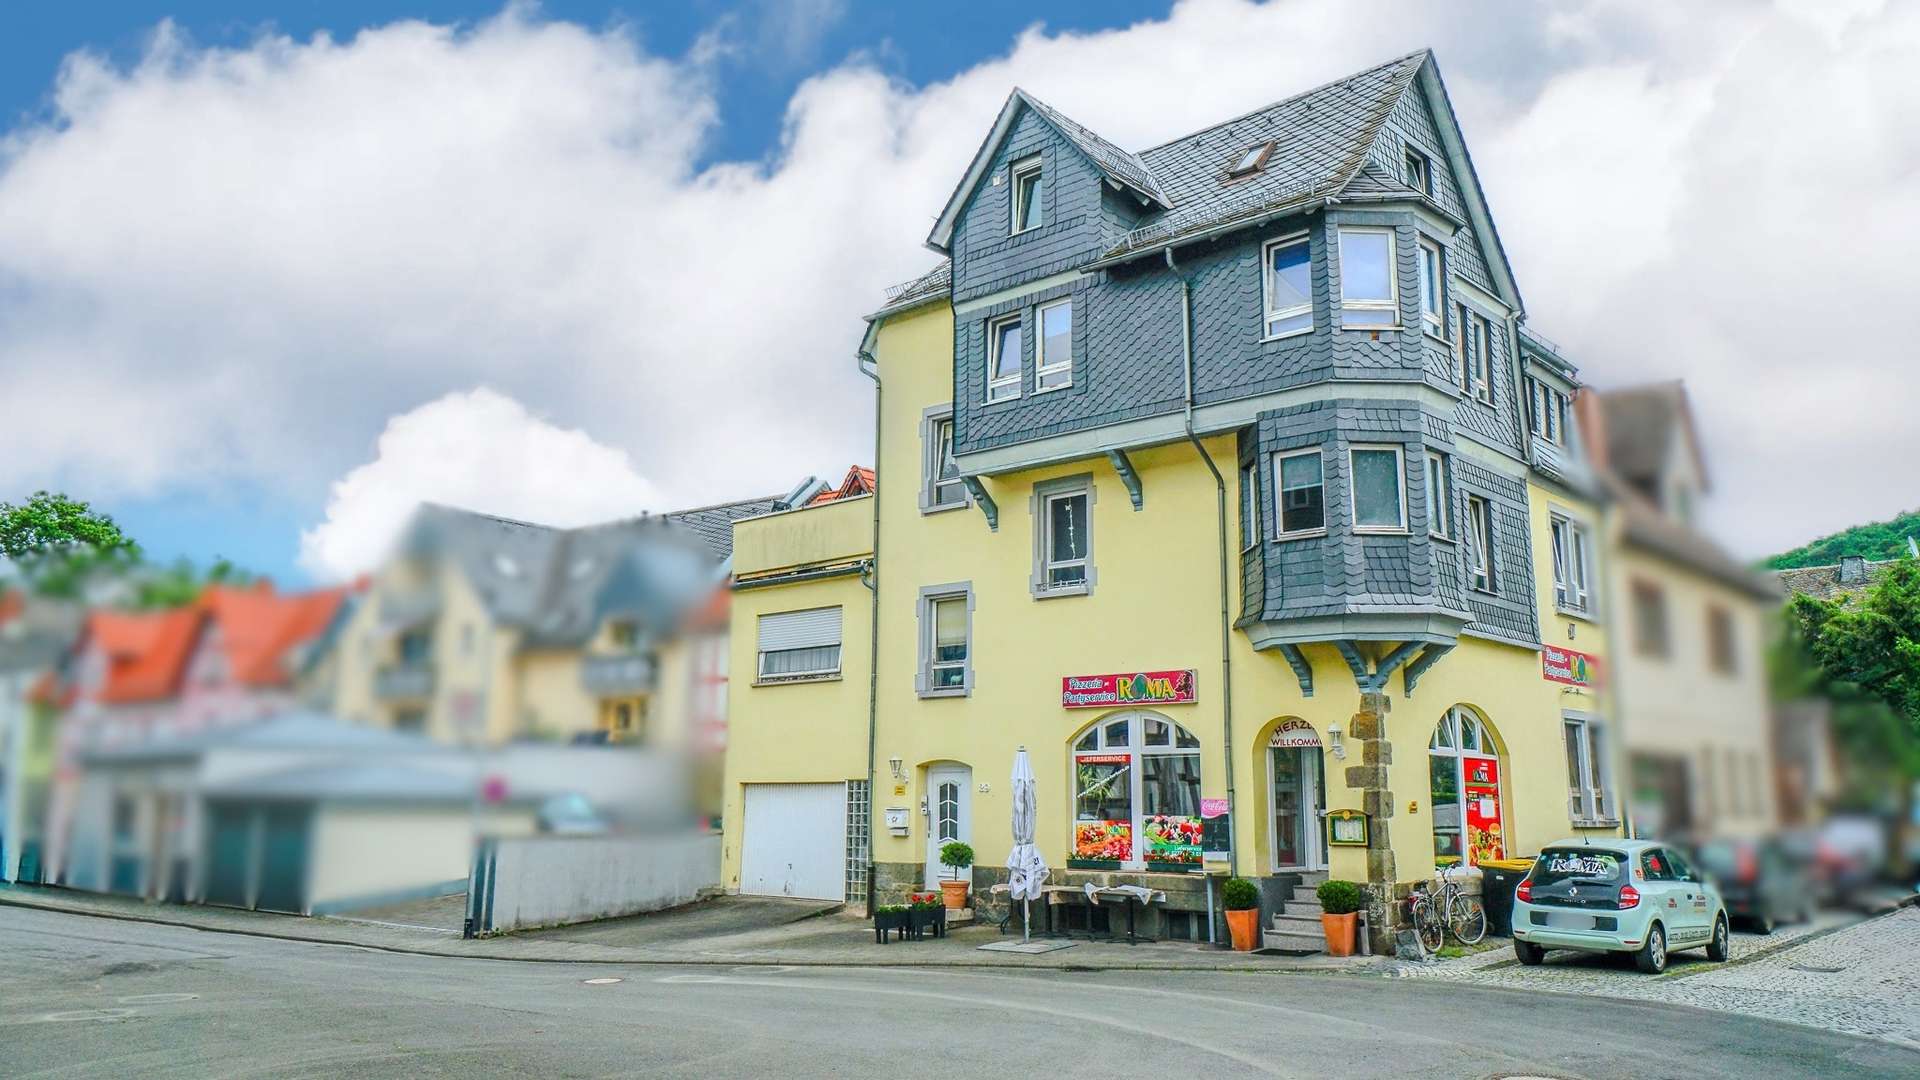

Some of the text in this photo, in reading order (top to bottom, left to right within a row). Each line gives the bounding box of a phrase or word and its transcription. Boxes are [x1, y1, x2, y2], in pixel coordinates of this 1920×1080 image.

[1116, 673, 1175, 701] ROMA
[1063, 691, 1115, 705] Partyservice
[1274, 720, 1315, 736] HERZL
[1550, 858, 1608, 874] ROMA
